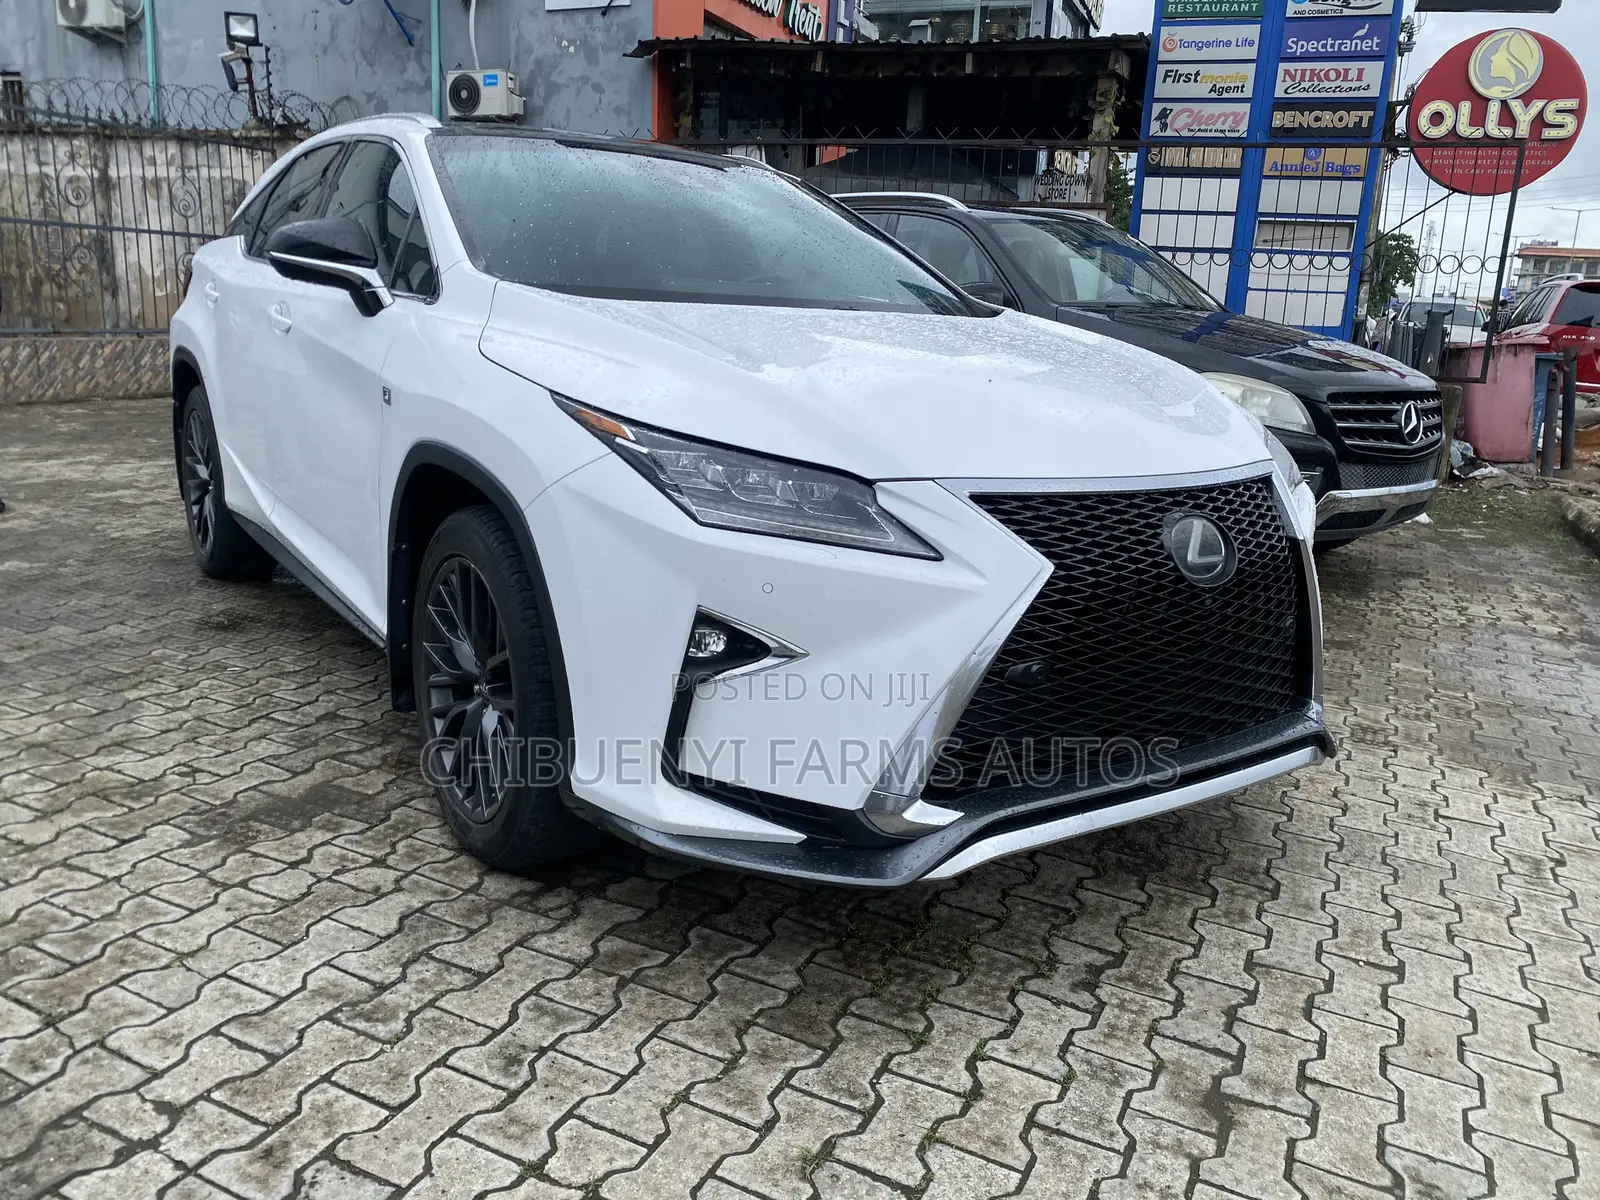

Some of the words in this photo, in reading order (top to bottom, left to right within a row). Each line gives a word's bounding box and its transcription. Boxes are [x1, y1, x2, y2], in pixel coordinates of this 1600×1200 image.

[1168, 3, 1258, 12] RESTAURANT
[1179, 38, 1232, 51] Tangerine
[1236, 37, 1255, 48] Life
[1287, 36, 1380, 55] Spectranet
[1282, 68, 1365, 82] NIKOLI
[1208, 83, 1245, 96] Agent
[1284, 81, 1371, 95] Collections
[1169, 107, 1247, 133] Cherry
[1272, 110, 1374, 128] BENCROFT
[1417, 98, 1580, 140] OLLYS
[1324, 162, 1361, 175] Bags
[1046, 188, 1067, 199] STORE
